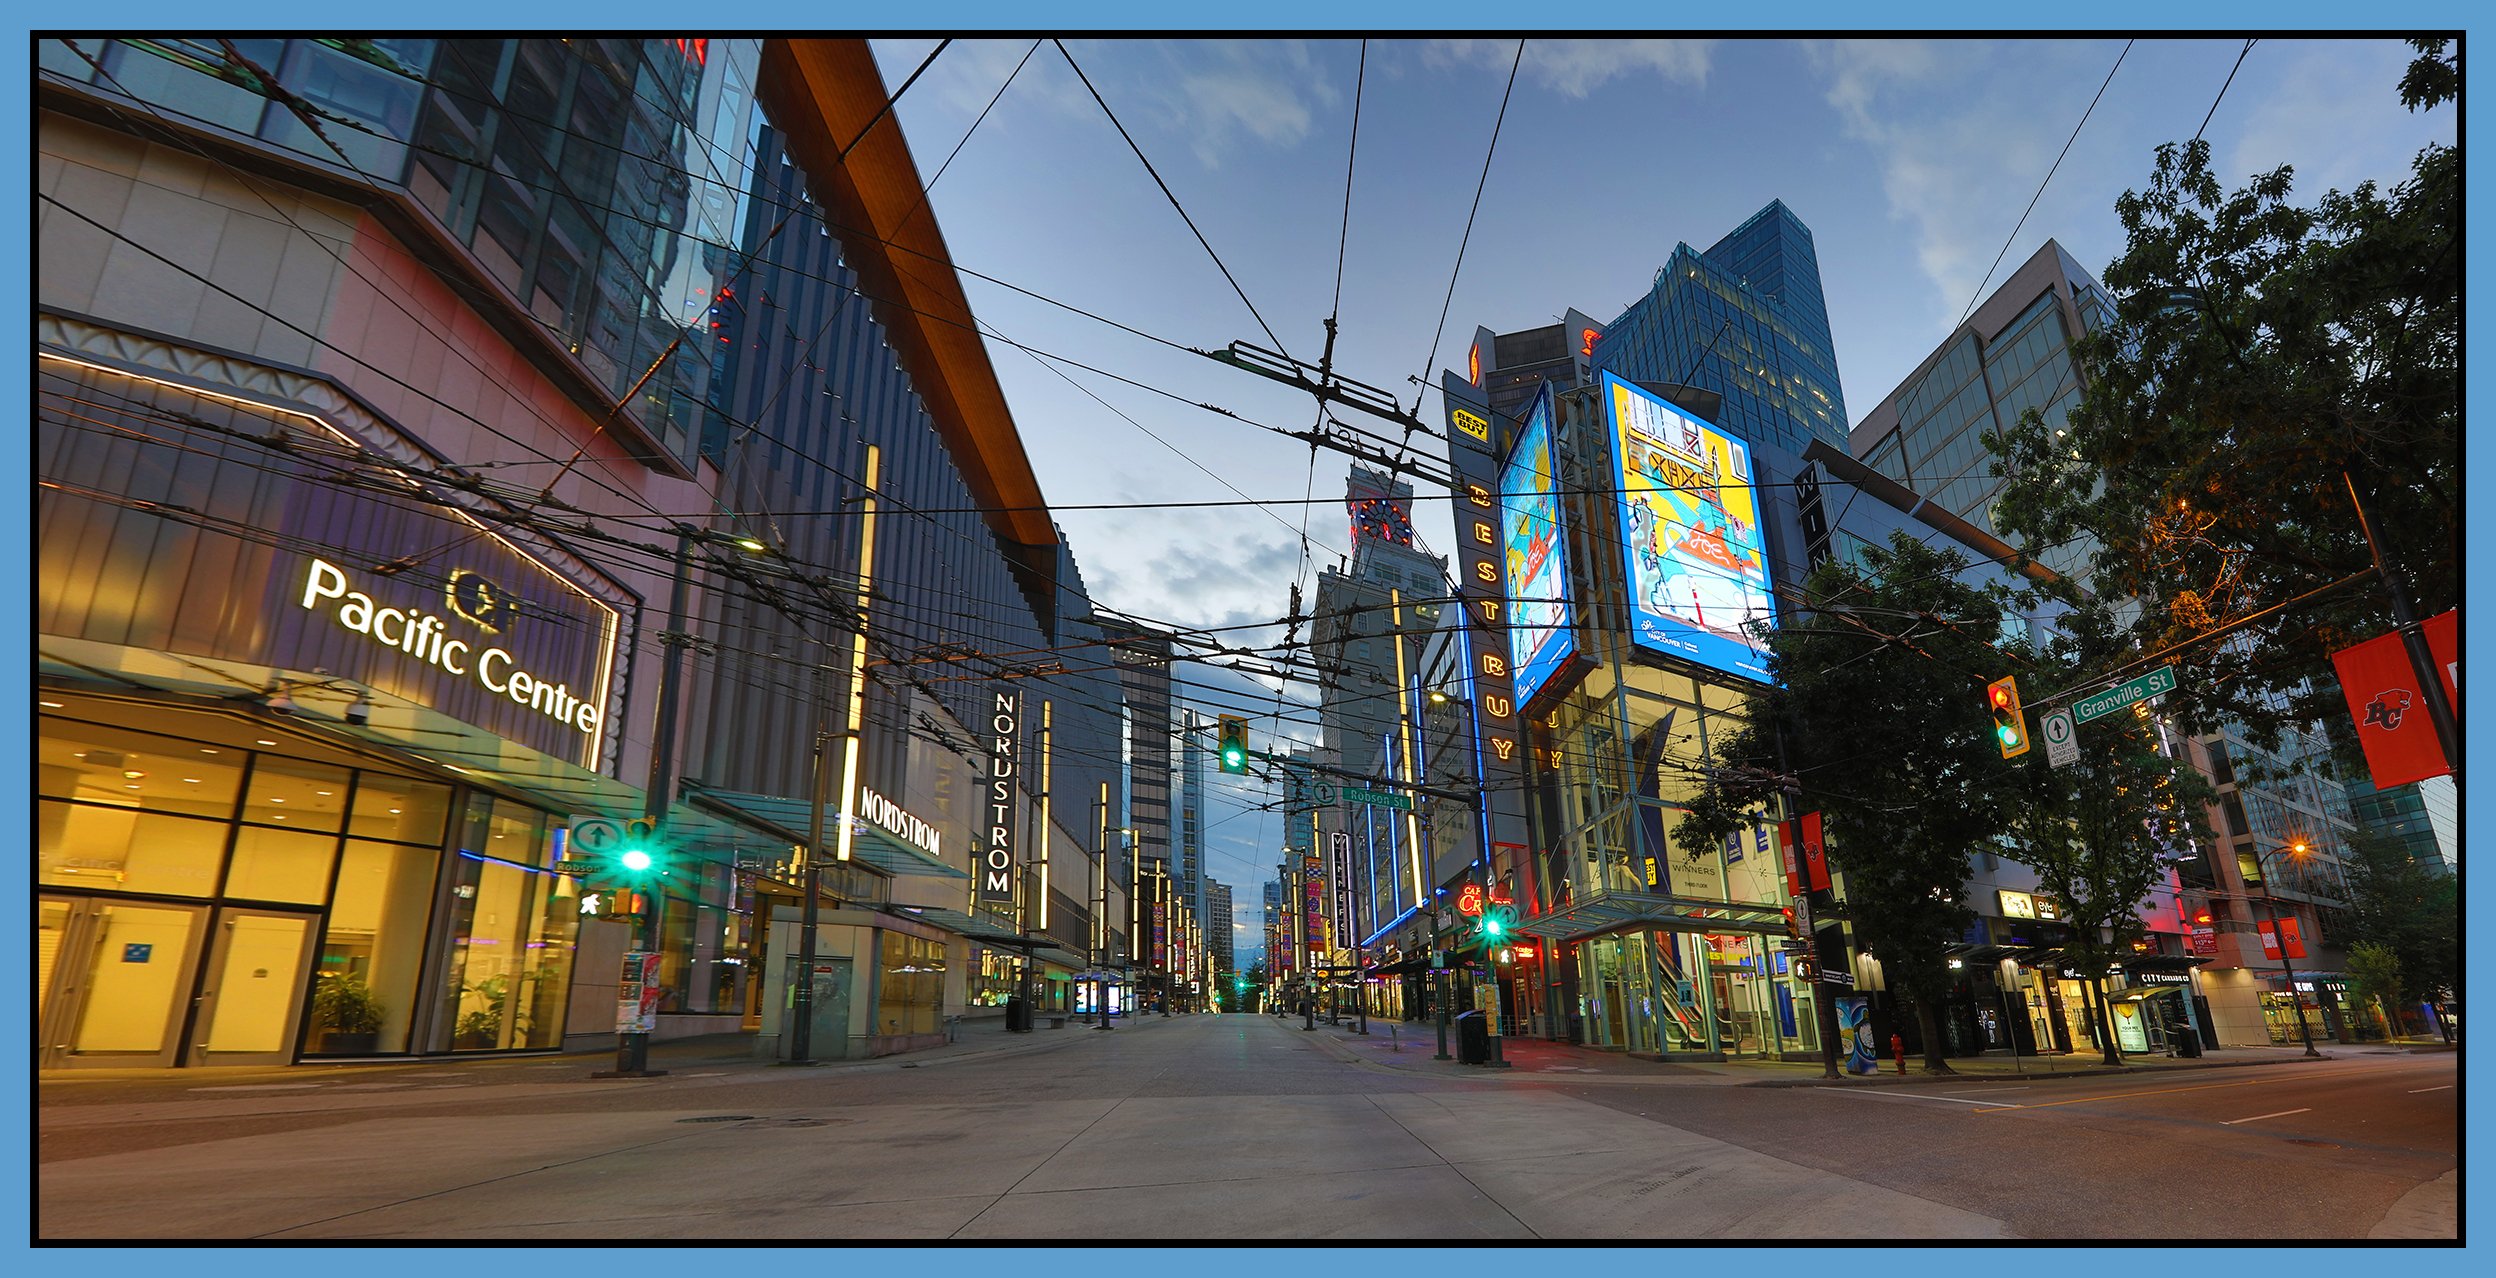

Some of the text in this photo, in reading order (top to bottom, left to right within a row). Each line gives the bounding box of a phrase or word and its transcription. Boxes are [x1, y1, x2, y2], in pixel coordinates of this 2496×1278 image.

[1457, 411, 1487, 430] BEST
[1458, 419, 1484, 436] BUY
[1469, 484, 1513, 760] BEST BUY
[302, 558, 598, 733] Pacific Centre
[1646, 631, 1682, 649] VANCOUVER
[2080, 673, 2169, 718] Granville St
[2051, 748, 2076, 759] AUTHORIZED
[2053, 742, 2070, 752] EXCEPT
[2054, 754, 2075, 764] VEHICLES
[986, 693, 1015, 892] NORDSTROM
[1351, 790, 1404, 808] Robson St
[861, 786, 940, 856] NORDSTROM
[557, 862, 600, 873] Robson
[1646, 863, 1655, 873] EST
[1672, 864, 1716, 876] WINNERS
[2141, 973, 2161, 983] CITY
